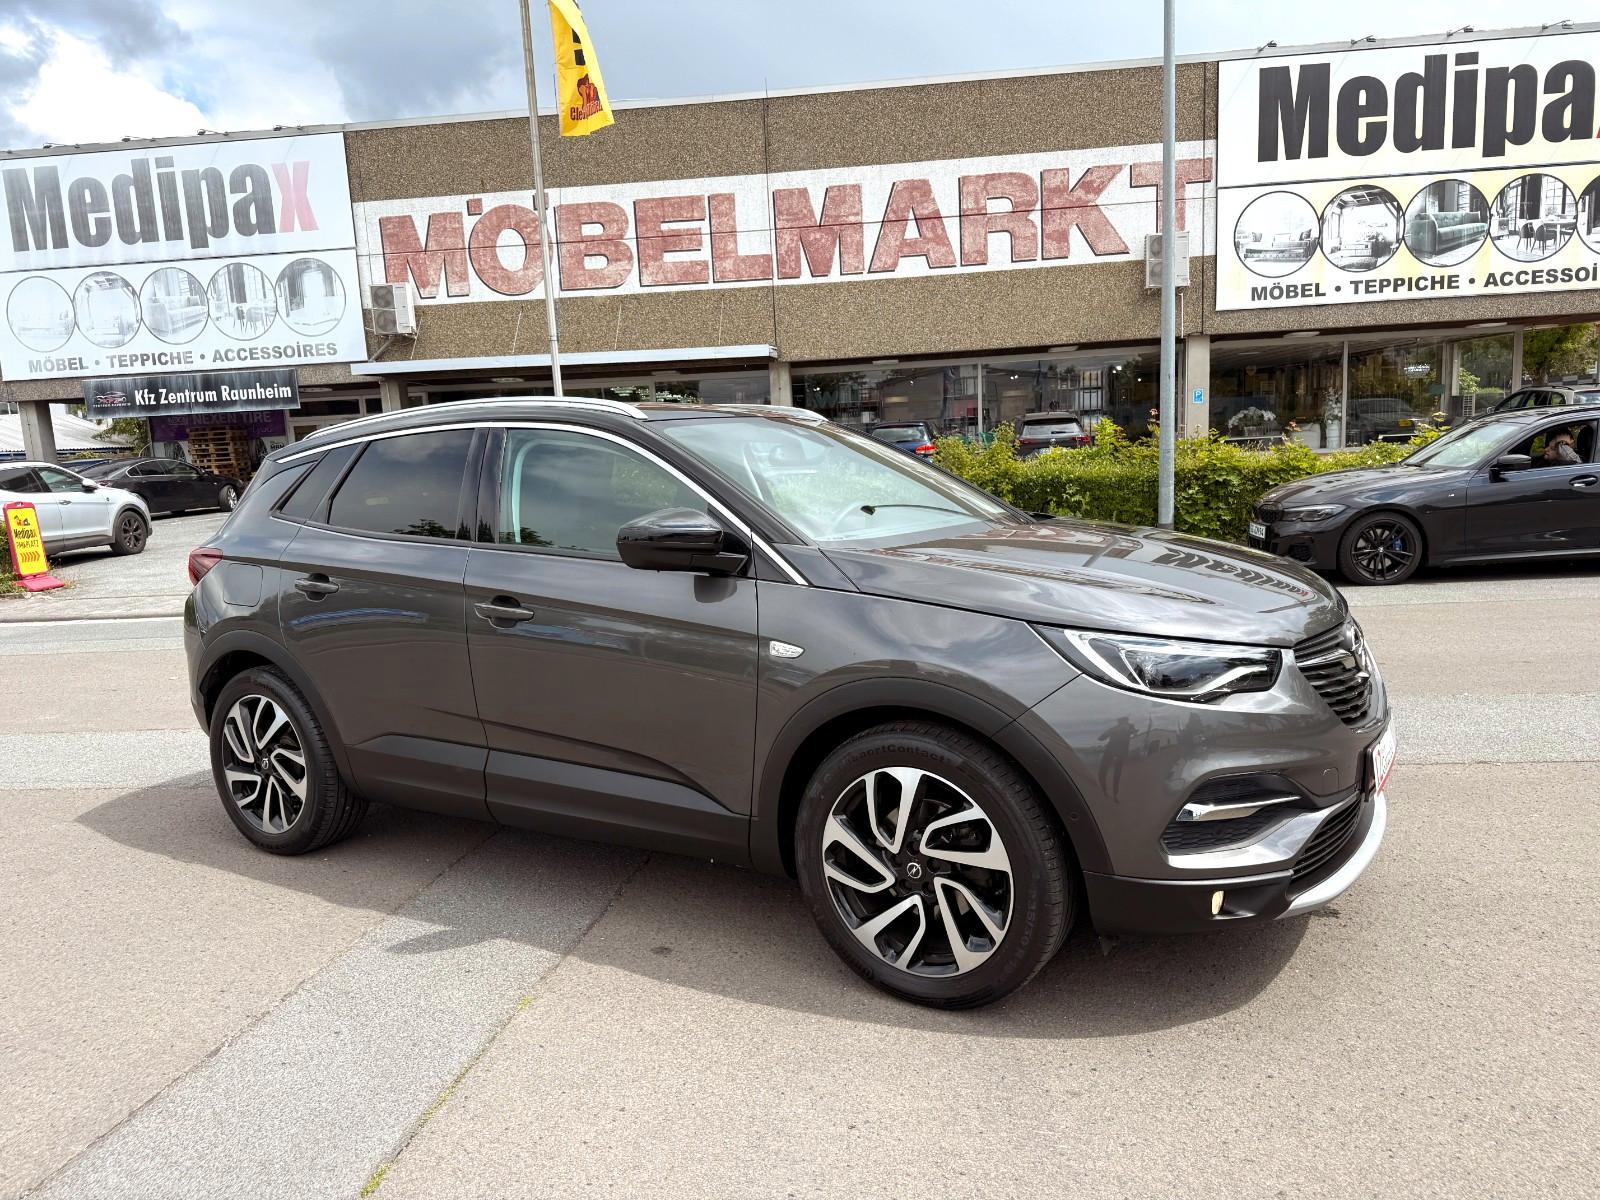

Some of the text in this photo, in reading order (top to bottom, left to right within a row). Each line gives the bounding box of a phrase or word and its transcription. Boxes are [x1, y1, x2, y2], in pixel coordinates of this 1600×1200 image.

[1258, 51, 1600, 163] Medipa
[2, 155, 319, 252] Medipax
[379, 157, 1213, 299] MÖBELMARKT
[1251, 282, 1326, 301] MÖBEL
[1350, 274, 1460, 295] TEPPICHE
[29, 356, 89, 373] MÖBEL
[106, 351, 194, 368] TEPPICHE
[134, 382, 292, 406] Kfz Zentrum Raunheim
